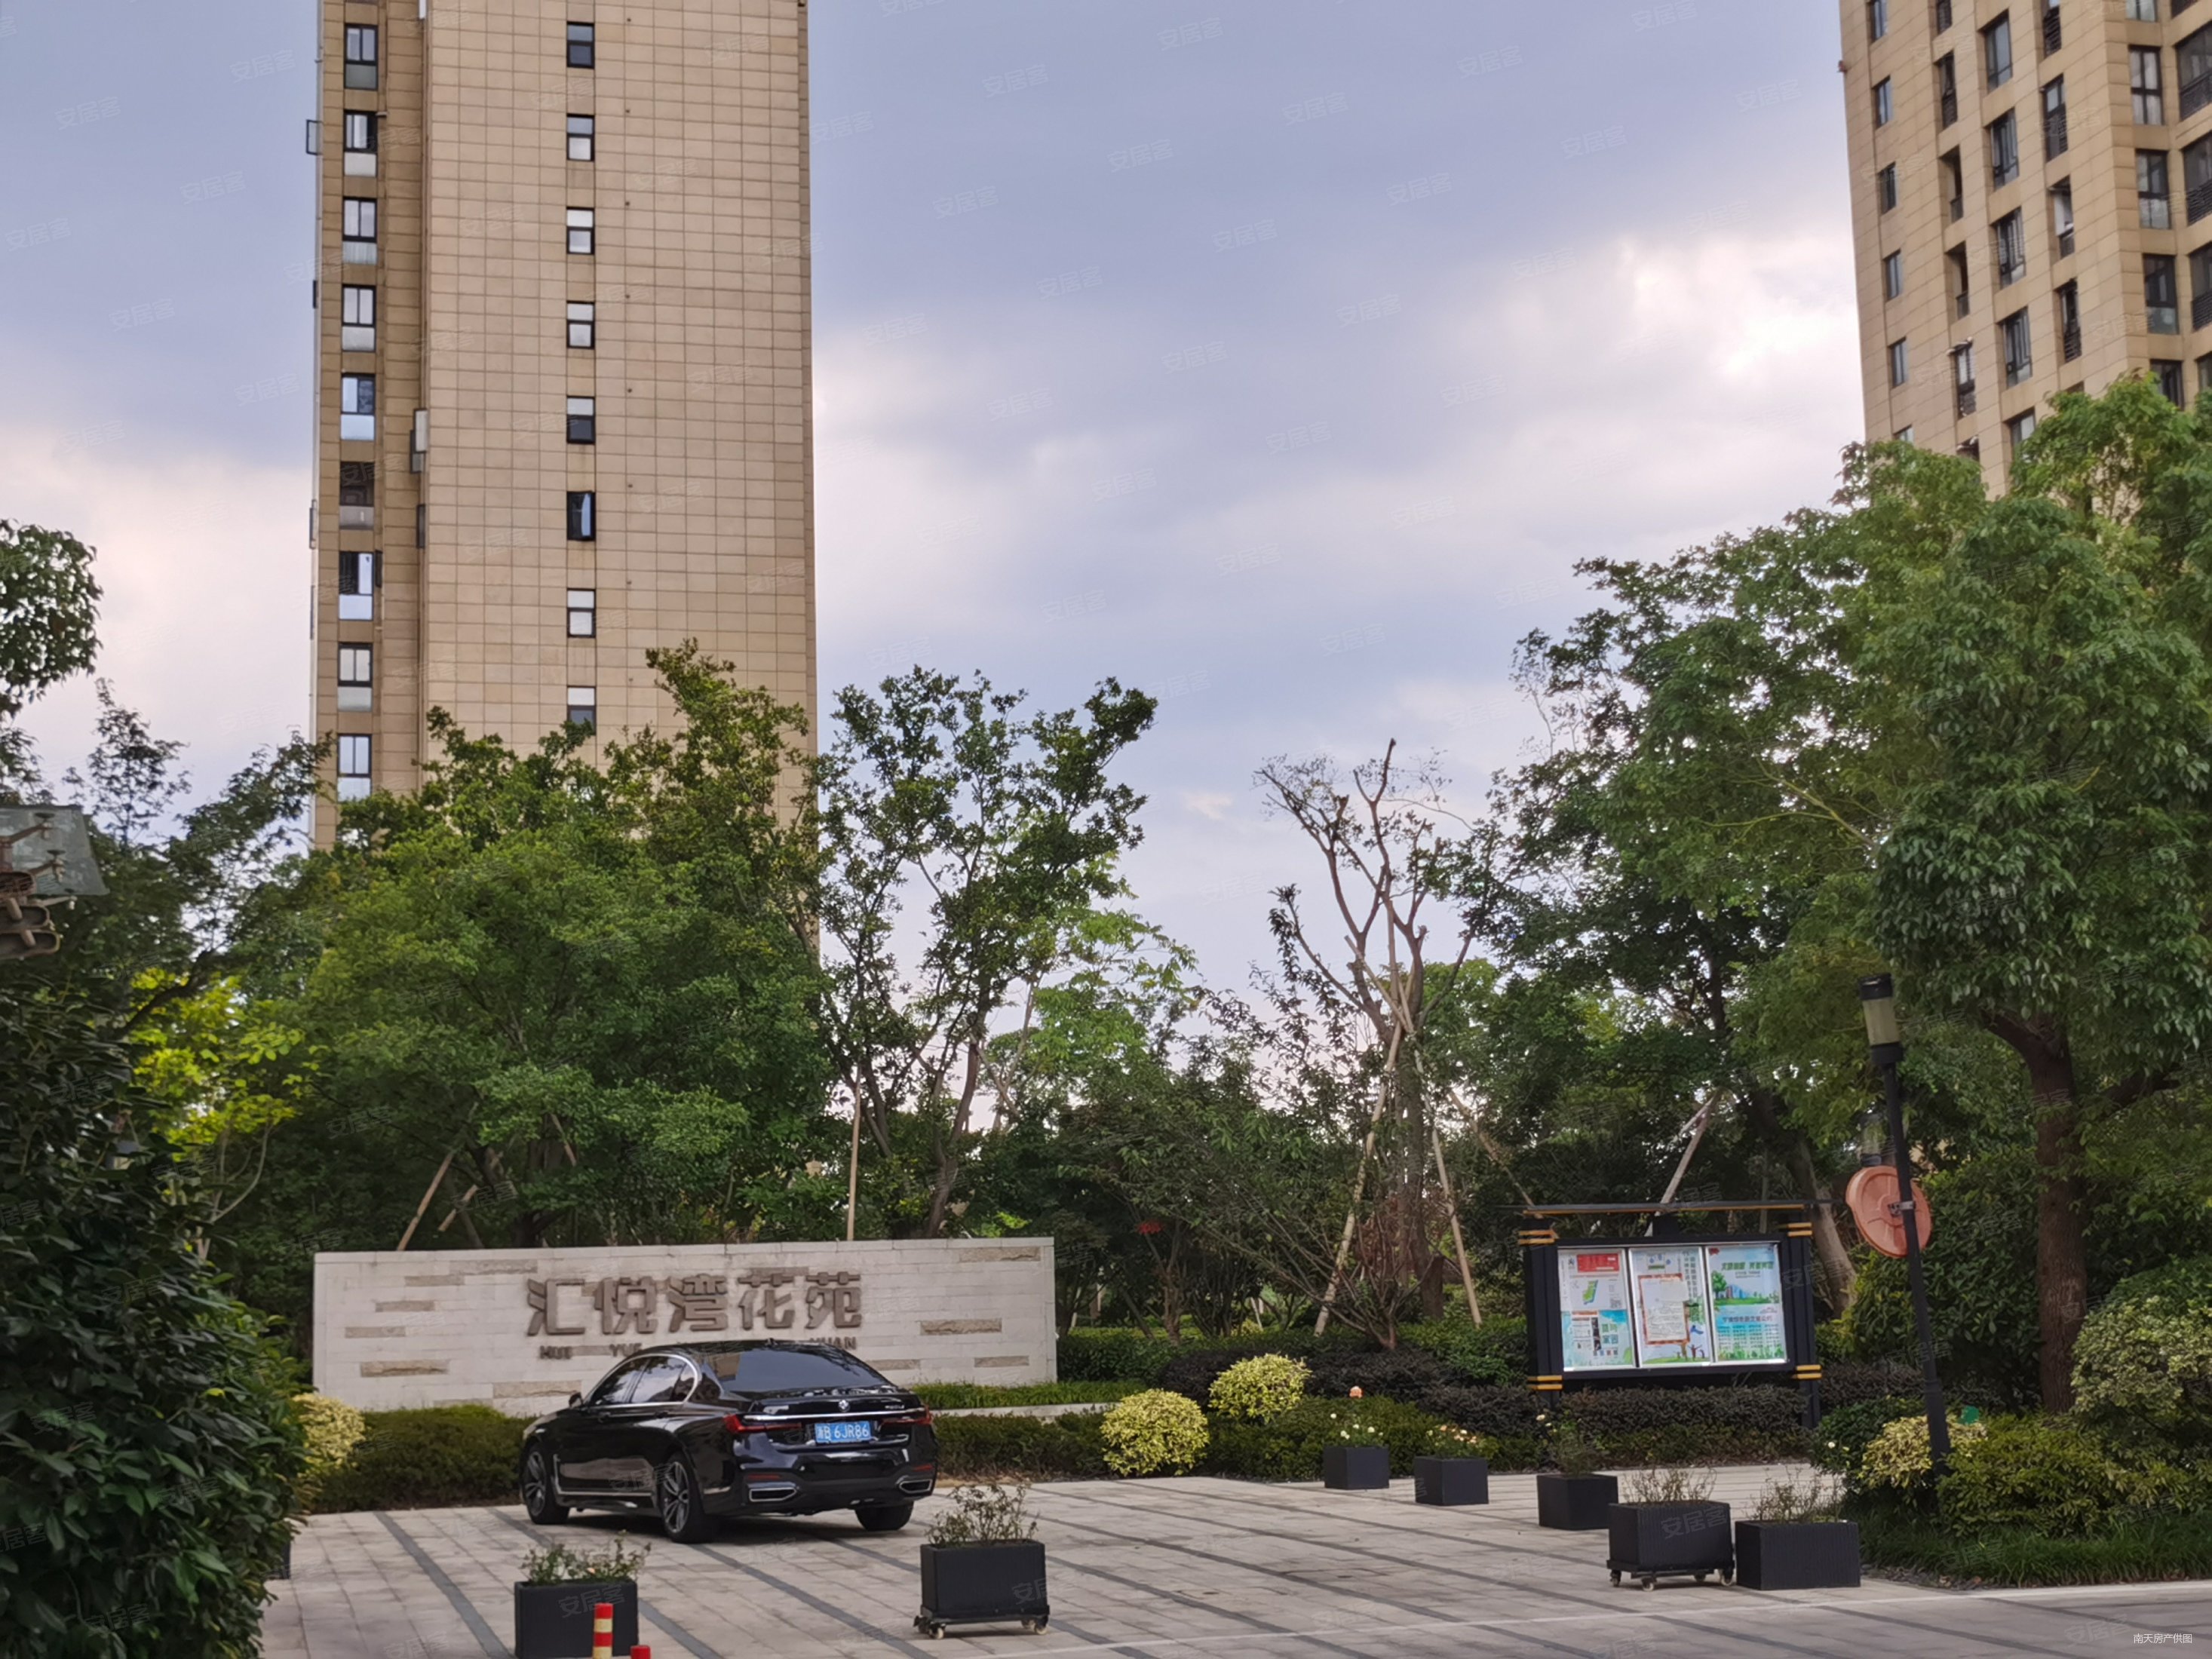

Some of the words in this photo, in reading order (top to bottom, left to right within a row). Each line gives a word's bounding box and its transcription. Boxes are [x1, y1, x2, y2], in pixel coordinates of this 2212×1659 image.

[526, 1271, 862, 1335] 汇悦湾花苑
